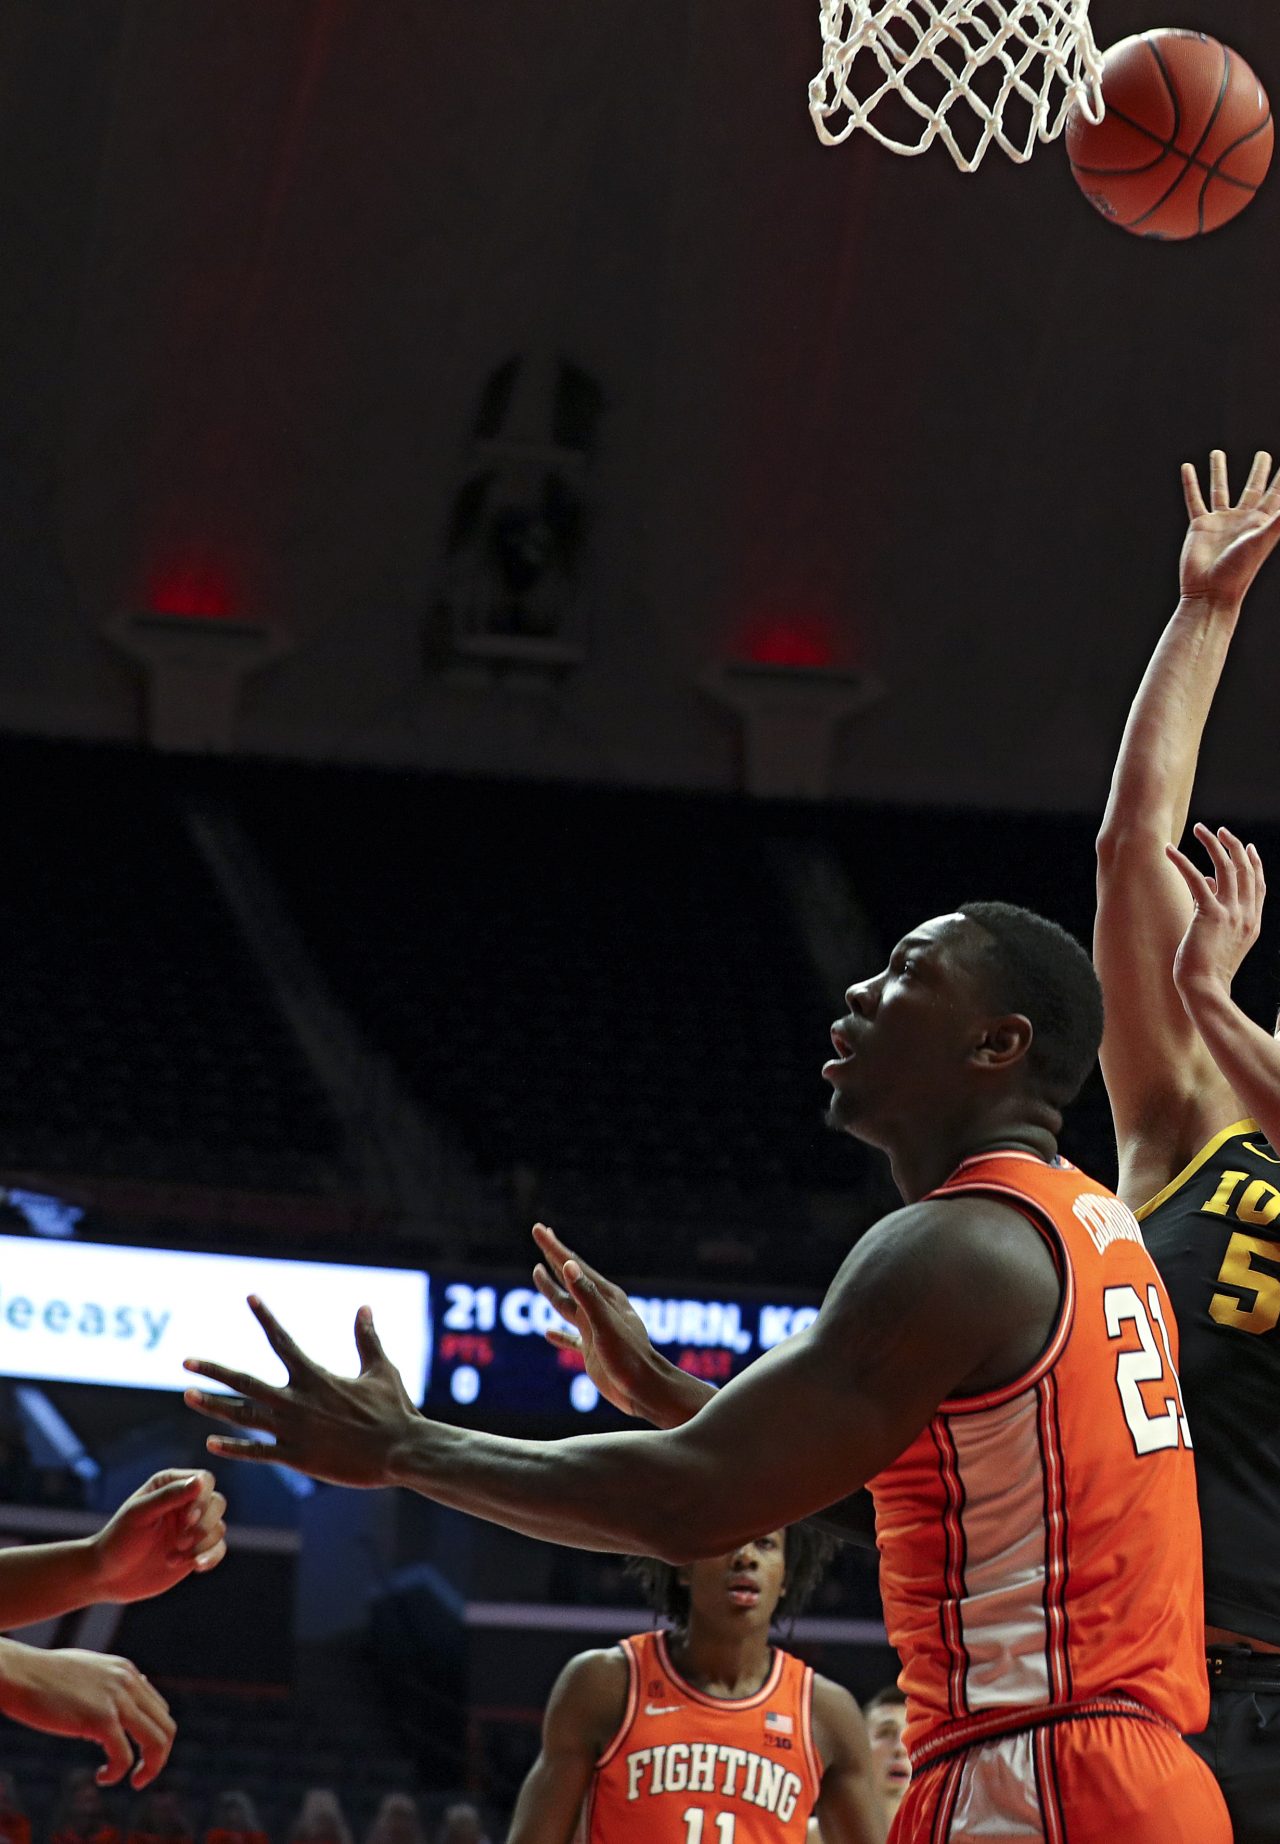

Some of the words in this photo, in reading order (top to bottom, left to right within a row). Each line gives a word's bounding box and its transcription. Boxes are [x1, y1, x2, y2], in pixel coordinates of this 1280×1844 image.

[0, 1282, 172, 1350] eeasy
[443, 1283, 497, 1332] 21
[451, 1365, 481, 1405] 0
[570, 1373, 599, 1413] 0
[626, 1743, 802, 1823] FIGHTING
[683, 1807, 736, 1844] 11
